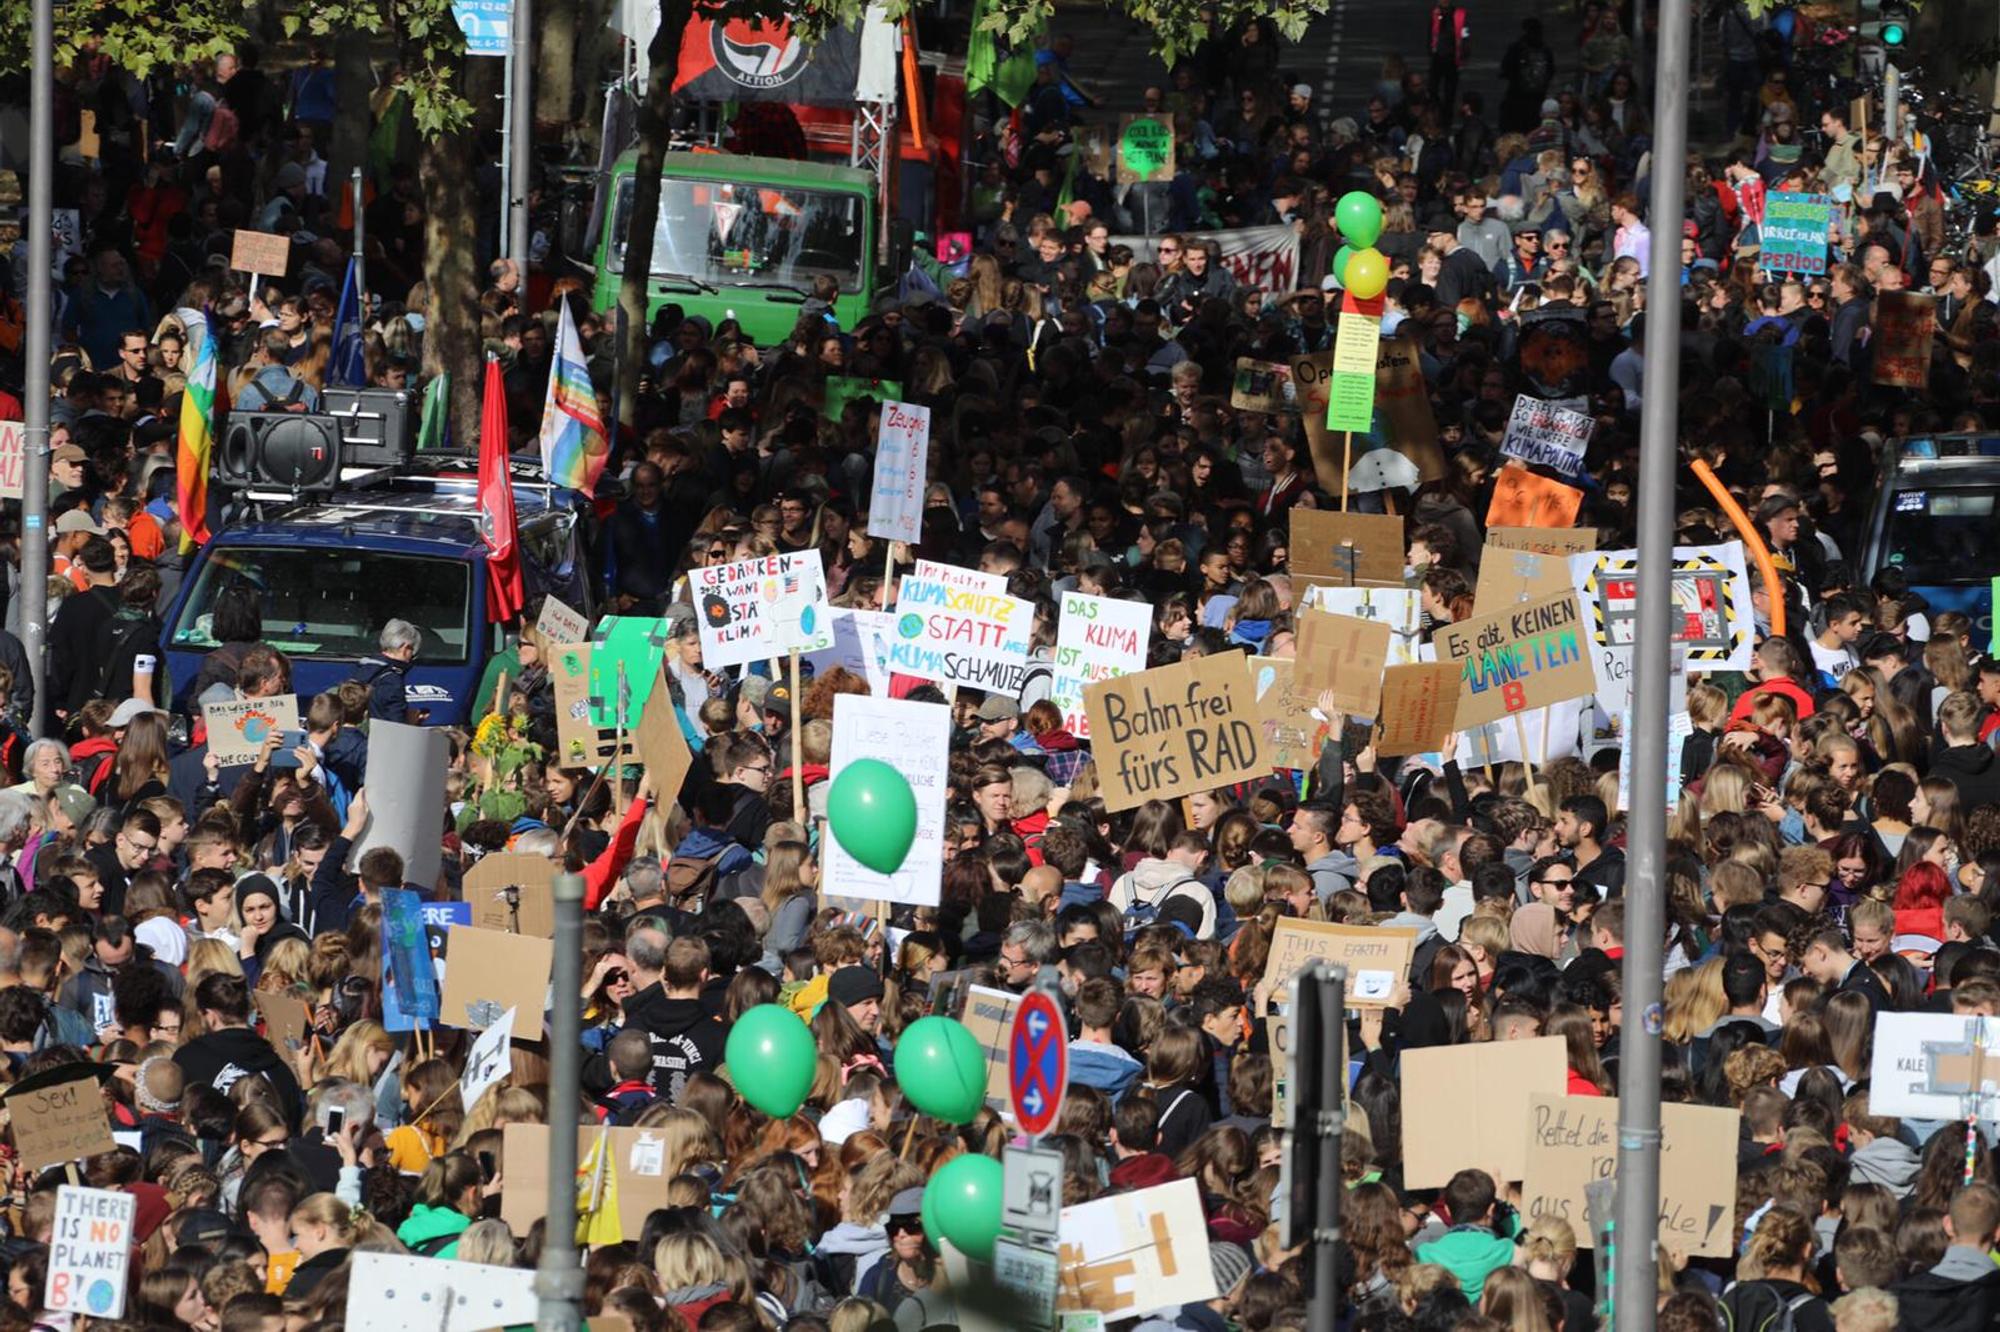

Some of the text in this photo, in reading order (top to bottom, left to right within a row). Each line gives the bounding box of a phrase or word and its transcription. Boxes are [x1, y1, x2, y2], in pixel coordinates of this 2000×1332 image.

[737, 73, 783, 87] AKTION
[1762, 250, 1824, 271] PERIOD
[1297, 361, 1333, 384] Op
[1513, 409, 1529, 421] SO
[1518, 396, 1552, 414] DIESES
[1516, 424, 1571, 447] WIE UNSERE
[1504, 433, 1581, 474] KLIMAPOLITIK
[1534, 542, 1556, 551] not
[703, 556, 803, 584] GEDANKEN-
[919, 562, 938, 577] Ihr
[902, 580, 1016, 622] KLIMASCHUTZ
[1067, 600, 1098, 620] DAS
[717, 624, 762, 644] KLIMA
[929, 614, 1008, 647] STATT
[1085, 624, 1137, 656] KLIMA
[1448, 599, 1576, 661] Es gibt KEINEN
[890, 643, 1025, 691] KLIMASCHMUTZ
[1057, 646, 1081, 667] IST
[1462, 628, 1580, 694] LANETEN
[1081, 663, 1130, 681] AUSS
[1502, 681, 1527, 712] B
[1104, 687, 1183, 744] Bahn
[1184, 681, 1232, 723] frei
[1186, 721, 1257, 779] RAD
[1284, 934, 1389, 958] THIS EARTH
[1535, 1104, 1610, 1147] Rettet die
[1591, 1154, 1618, 1180] ra
[63, 1192, 130, 1220] THERE
[61, 1217, 121, 1243] IS NO
[54, 1243, 125, 1271] PLANET
